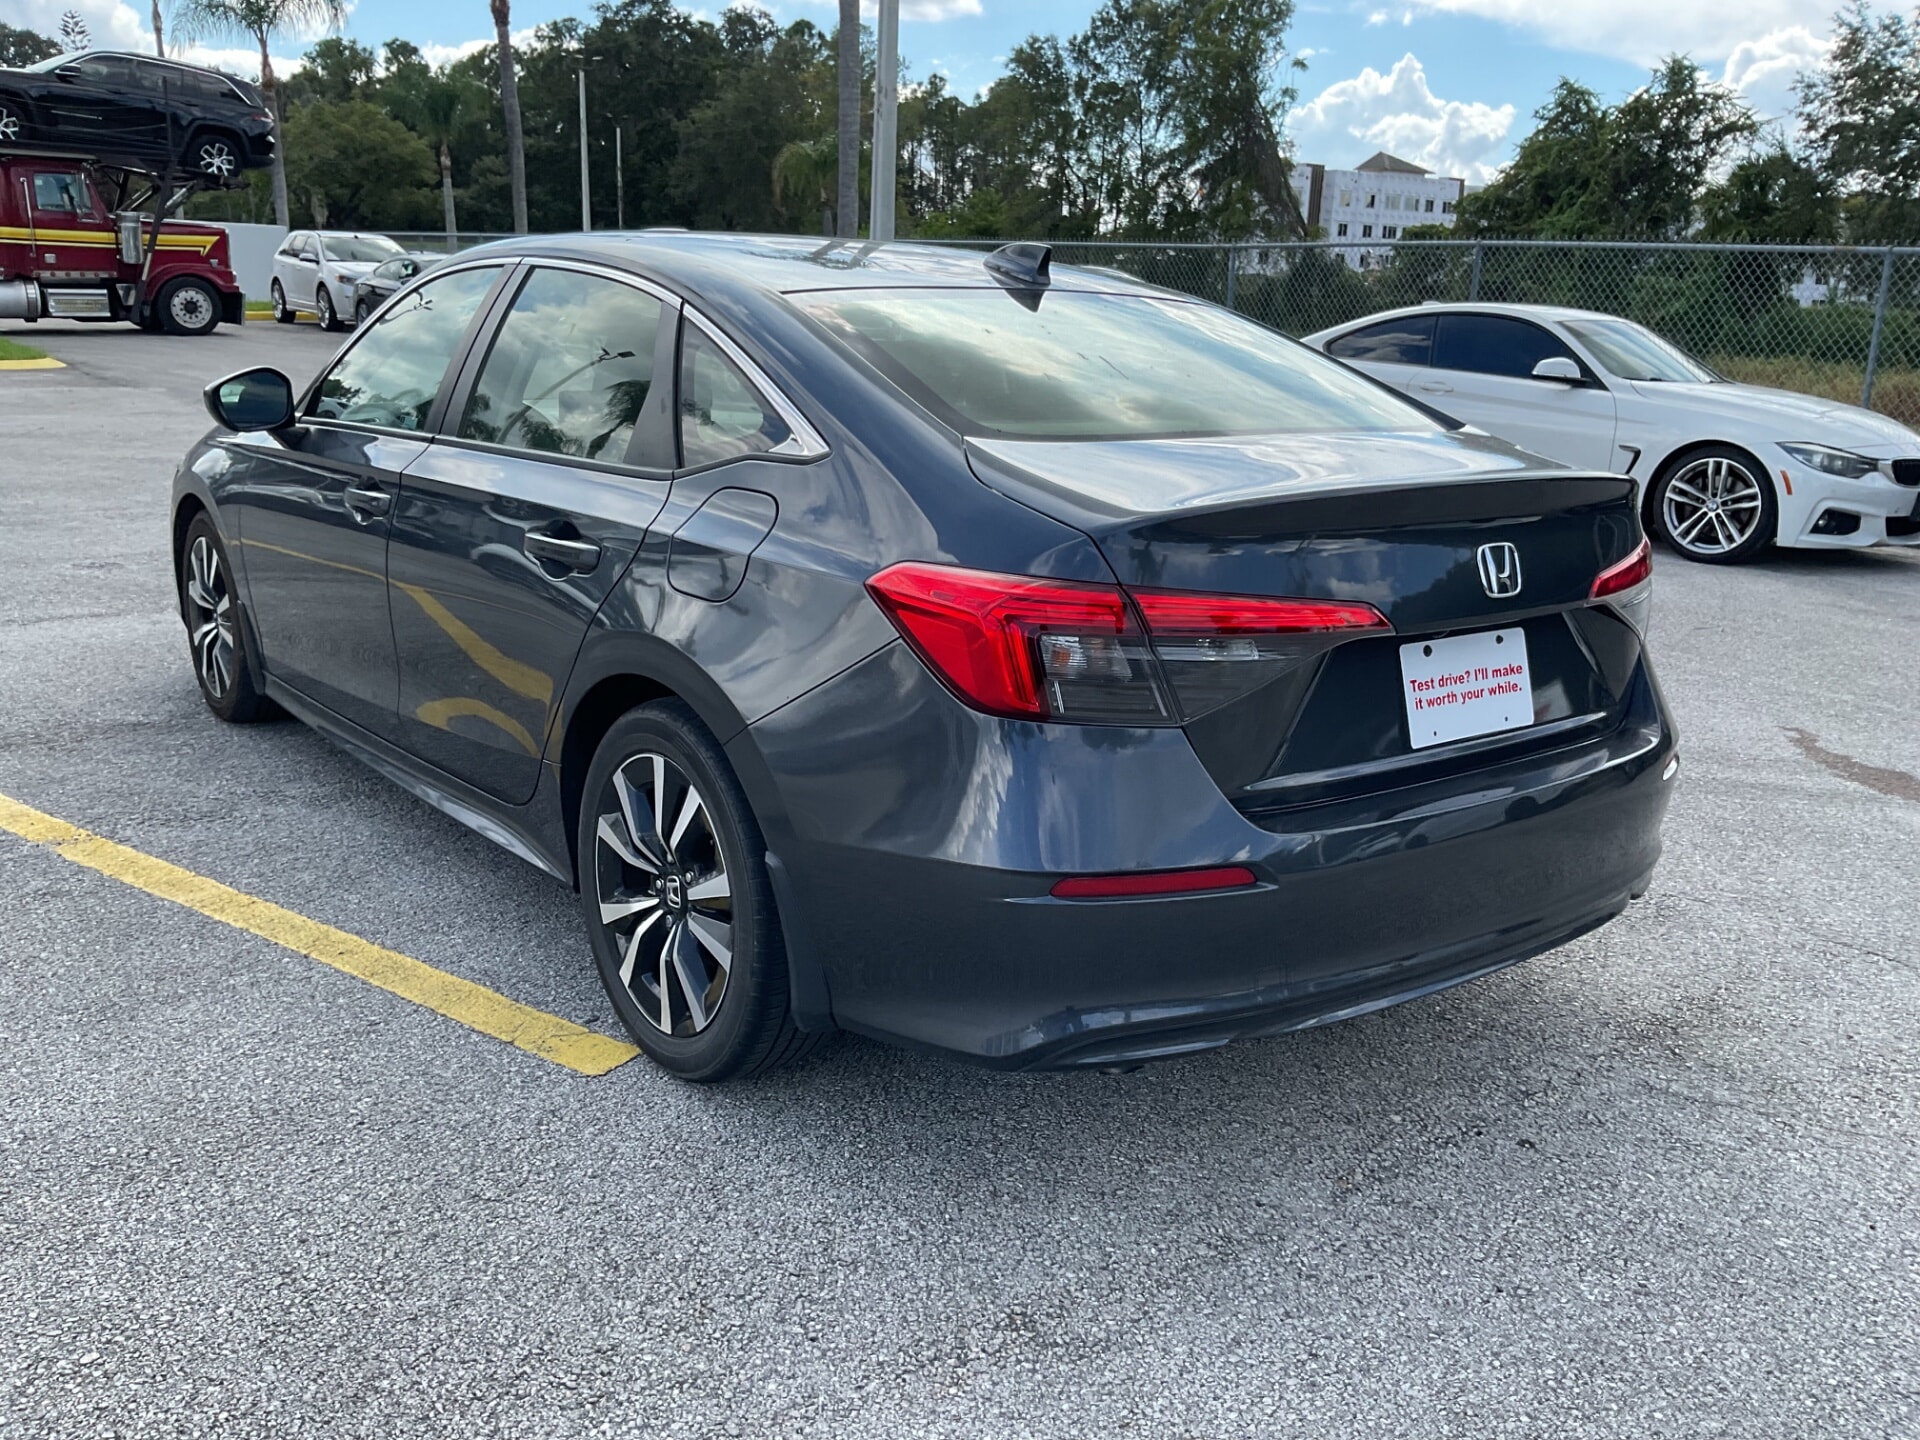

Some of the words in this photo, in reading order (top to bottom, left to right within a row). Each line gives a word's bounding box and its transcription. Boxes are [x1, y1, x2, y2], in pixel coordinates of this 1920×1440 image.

[1410, 678, 1435, 693] Test
[1438, 670, 1470, 688] drive?
[1474, 668, 1488, 681] I'll
[1492, 664, 1523, 678] make
[1415, 698, 1423, 710] it
[1426, 691, 1457, 708] worth
[1461, 688, 1484, 704] your
[1488, 681, 1522, 696] while.
